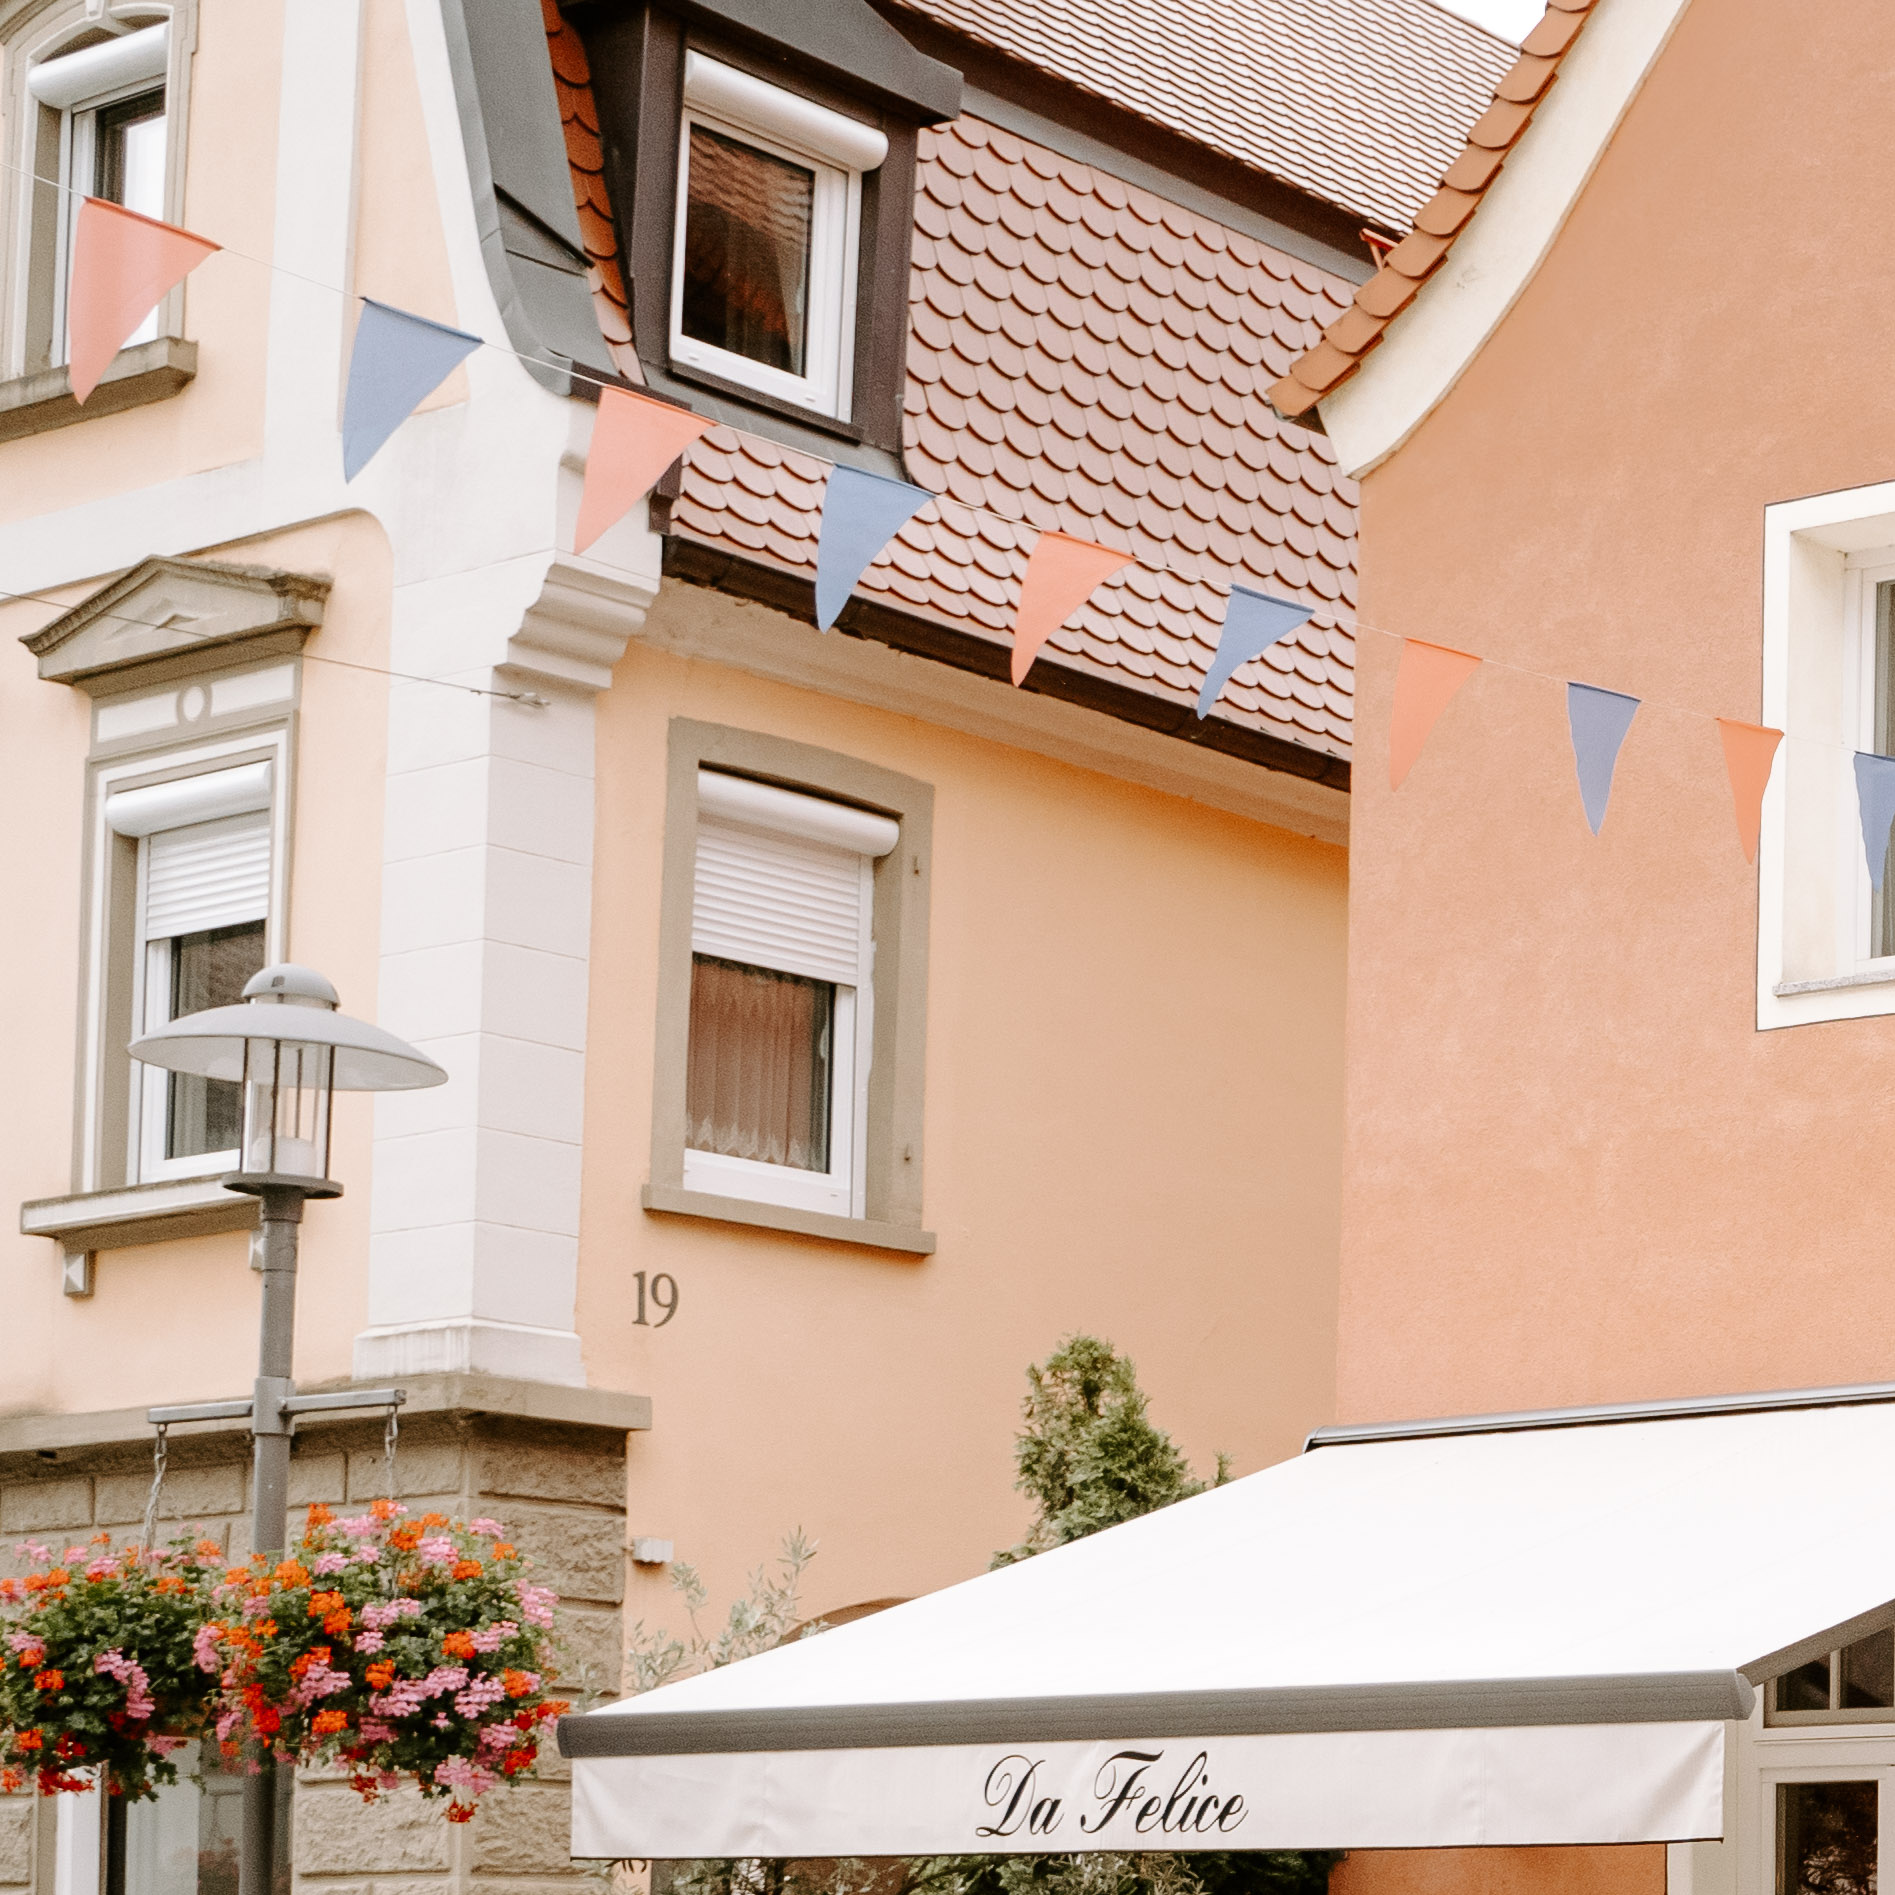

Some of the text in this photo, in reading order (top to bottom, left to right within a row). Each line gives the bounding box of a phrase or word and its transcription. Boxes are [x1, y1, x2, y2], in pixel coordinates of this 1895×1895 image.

[631, 1270, 679, 1329] 19
[975, 1750, 1250, 1838] Da Felice
